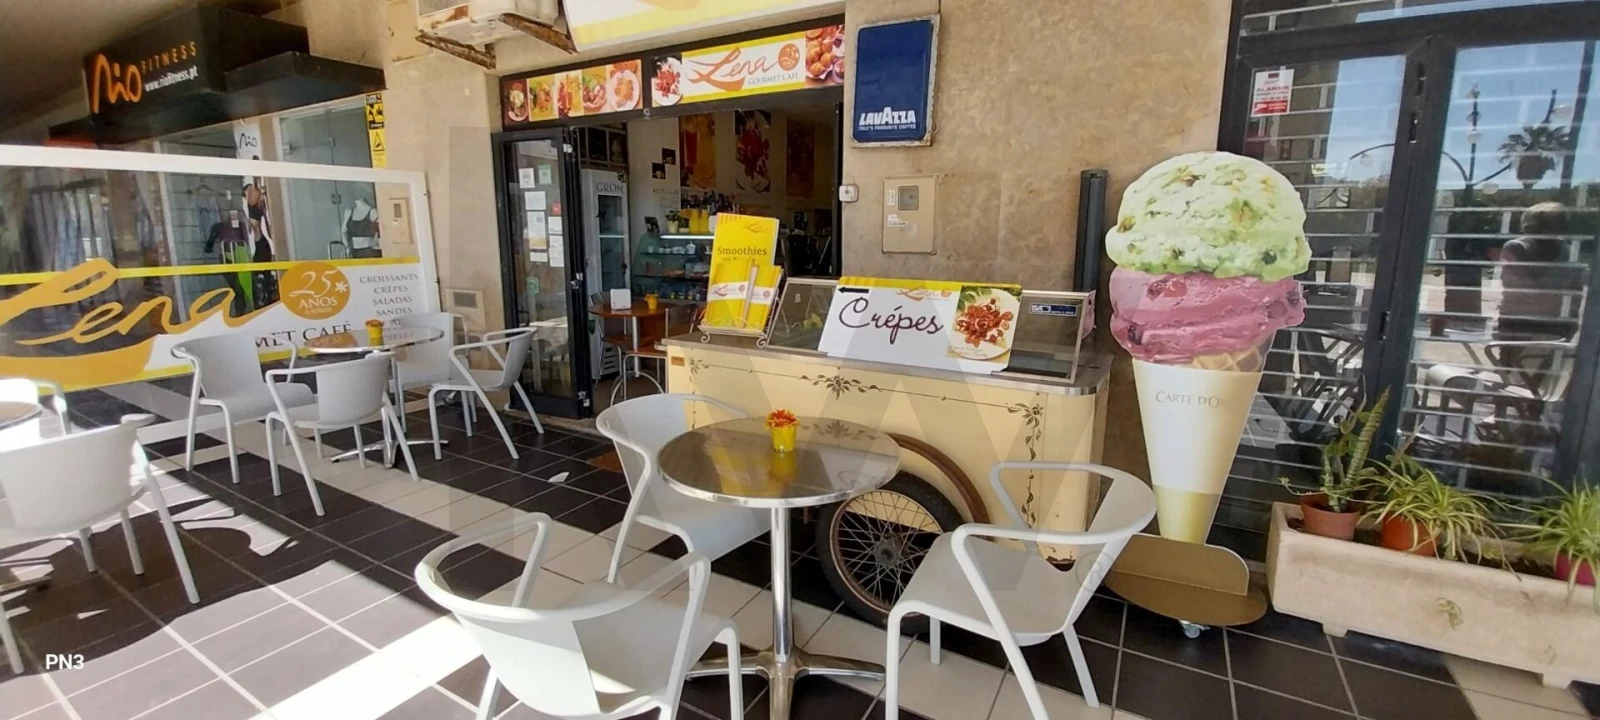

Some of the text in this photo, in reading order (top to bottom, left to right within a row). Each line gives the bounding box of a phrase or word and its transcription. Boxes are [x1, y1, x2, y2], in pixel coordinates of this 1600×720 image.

[141, 41, 198, 74] FITNESS
[687, 47, 779, 92] Lena
[747, 75, 781, 86] GOURMET
[859, 106, 917, 126] LAVAZZA
[717, 246, 768, 256] Smoothies
[359, 273, 419, 284] CROISSANTS
[373, 285, 409, 294] CRÊPES
[372, 296, 413, 306] SALADAS
[375, 307, 413, 316] SANDES
[838, 296, 944, 345] Crépes
